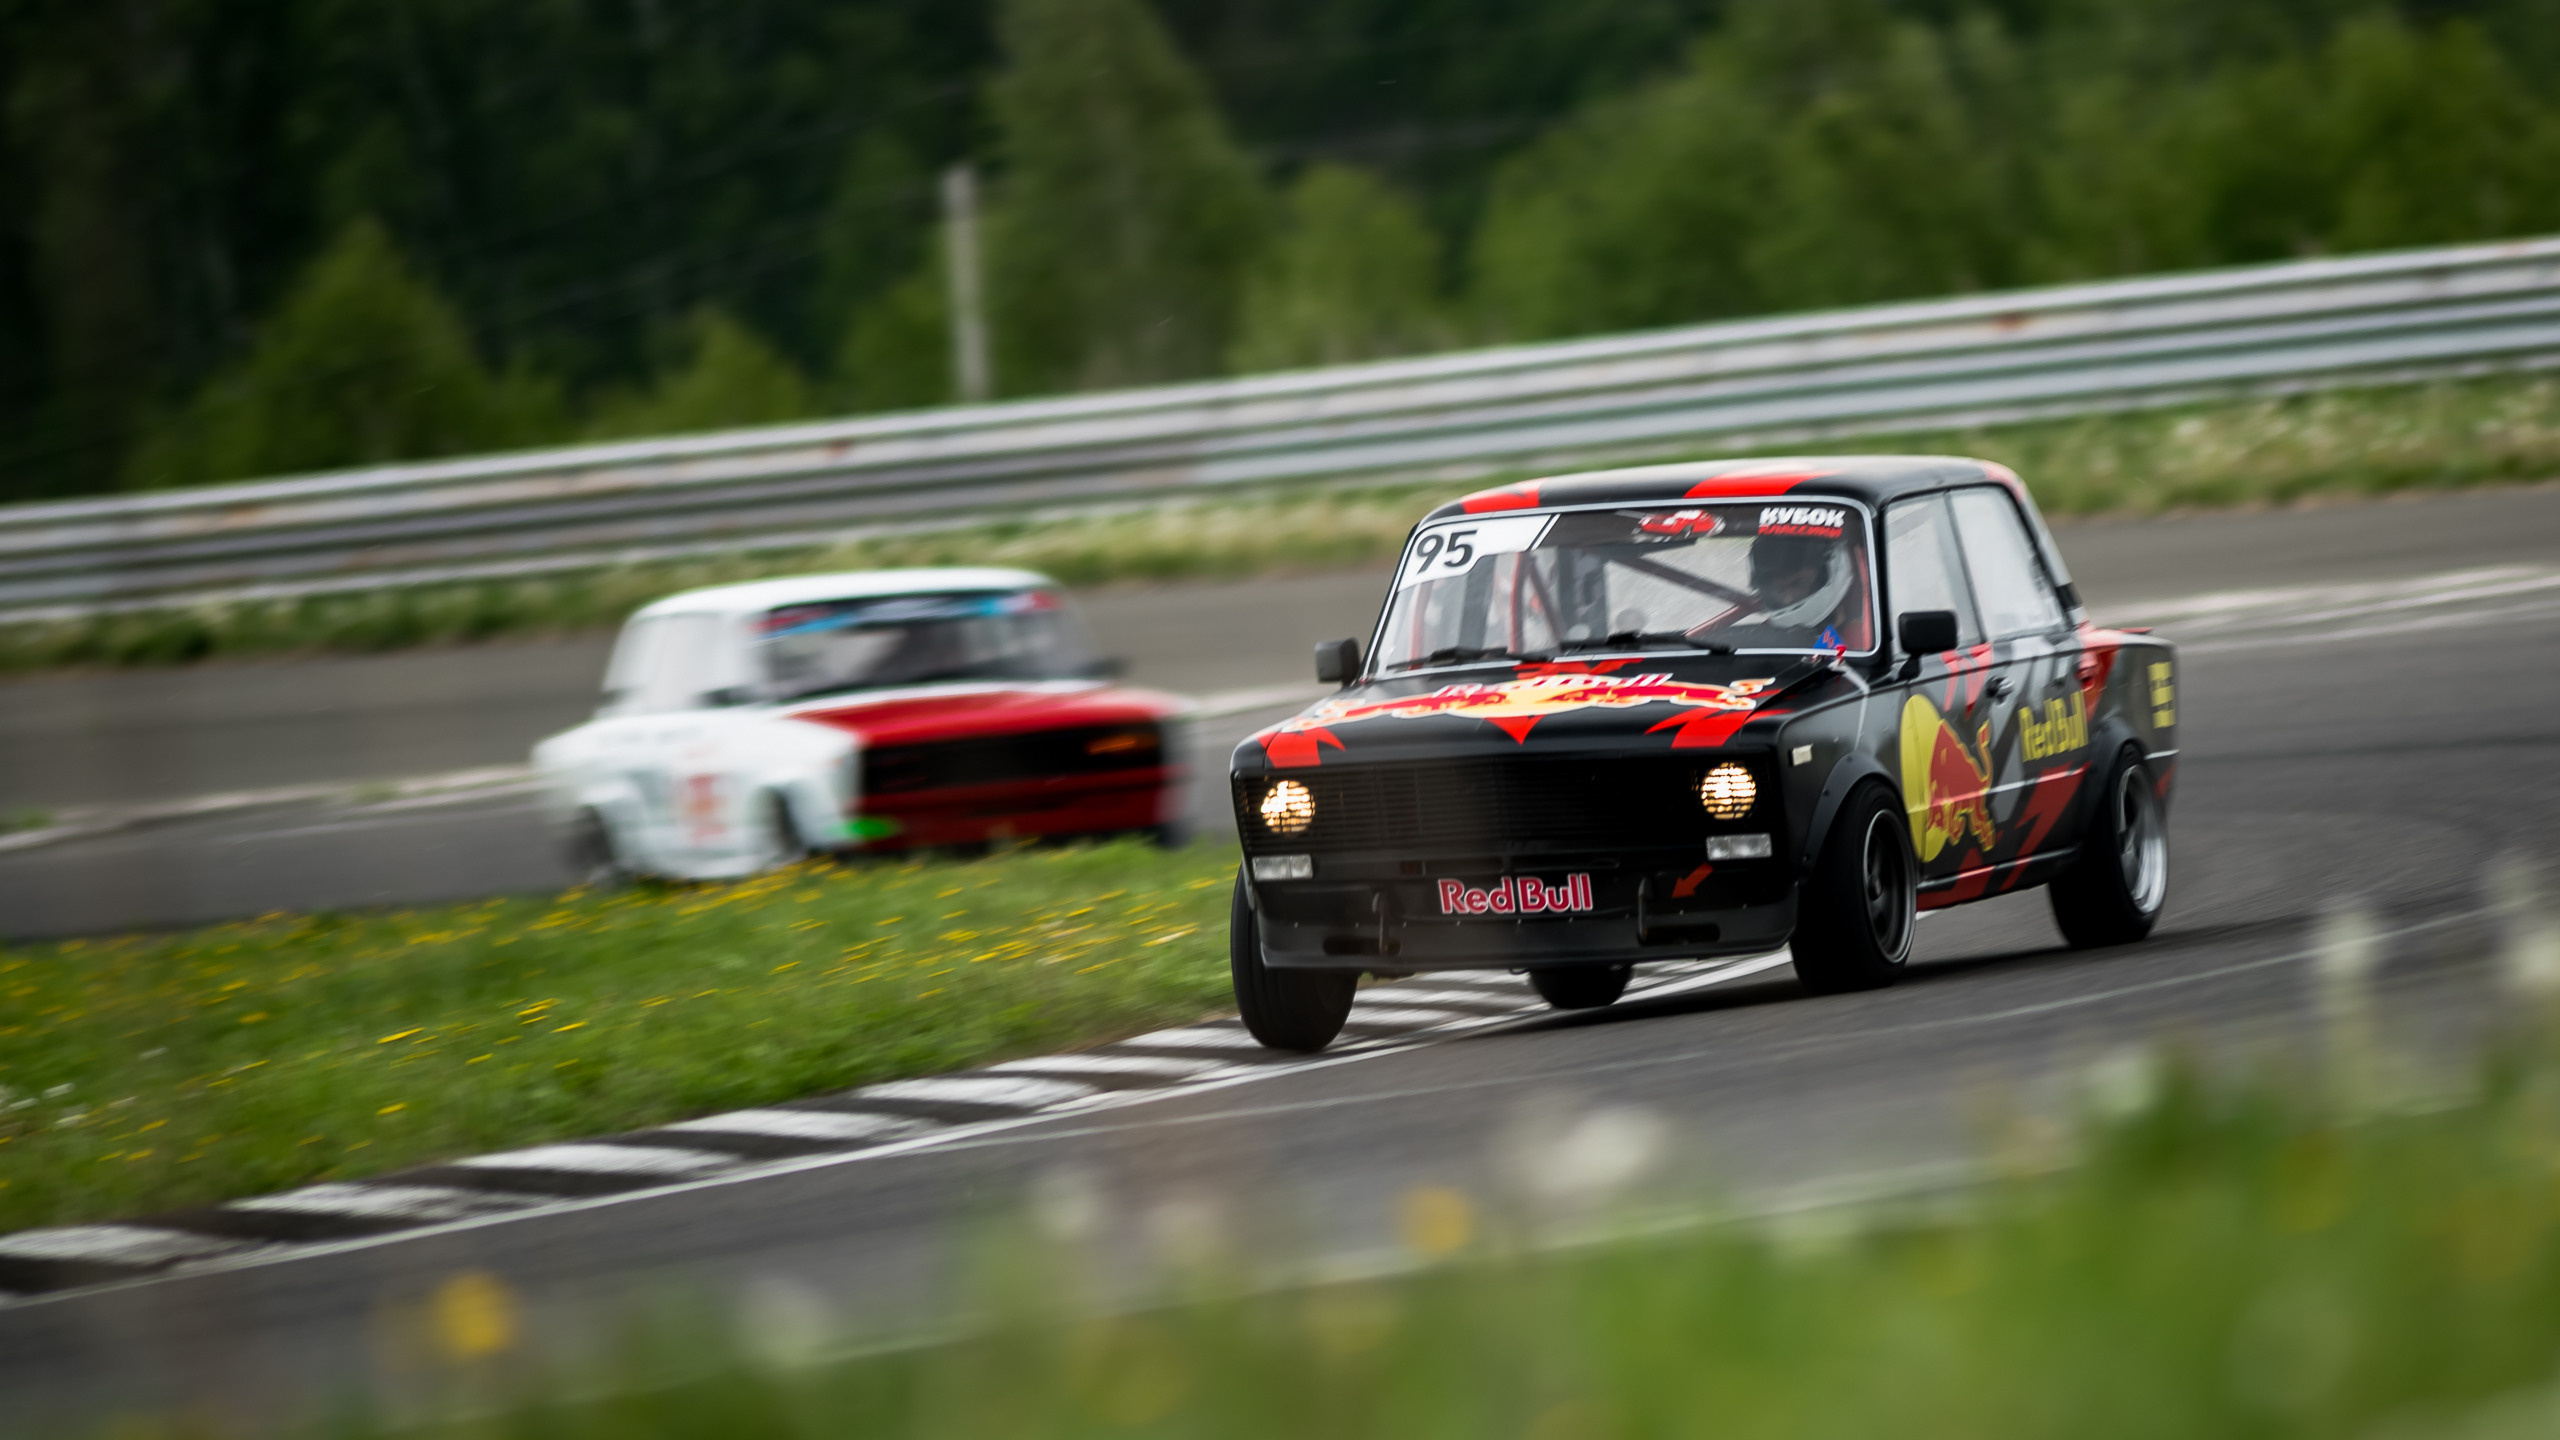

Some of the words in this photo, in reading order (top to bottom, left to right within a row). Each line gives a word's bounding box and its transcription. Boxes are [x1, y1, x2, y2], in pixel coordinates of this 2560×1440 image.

[1759, 507, 1846, 527] КУБОК
[1416, 529, 1478, 574] 95
[2018, 697, 2057, 763] Red
[2051, 690, 2089, 755] Bull
[1437, 876, 1515, 914] Red
[1517, 873, 1593, 913] Bull
